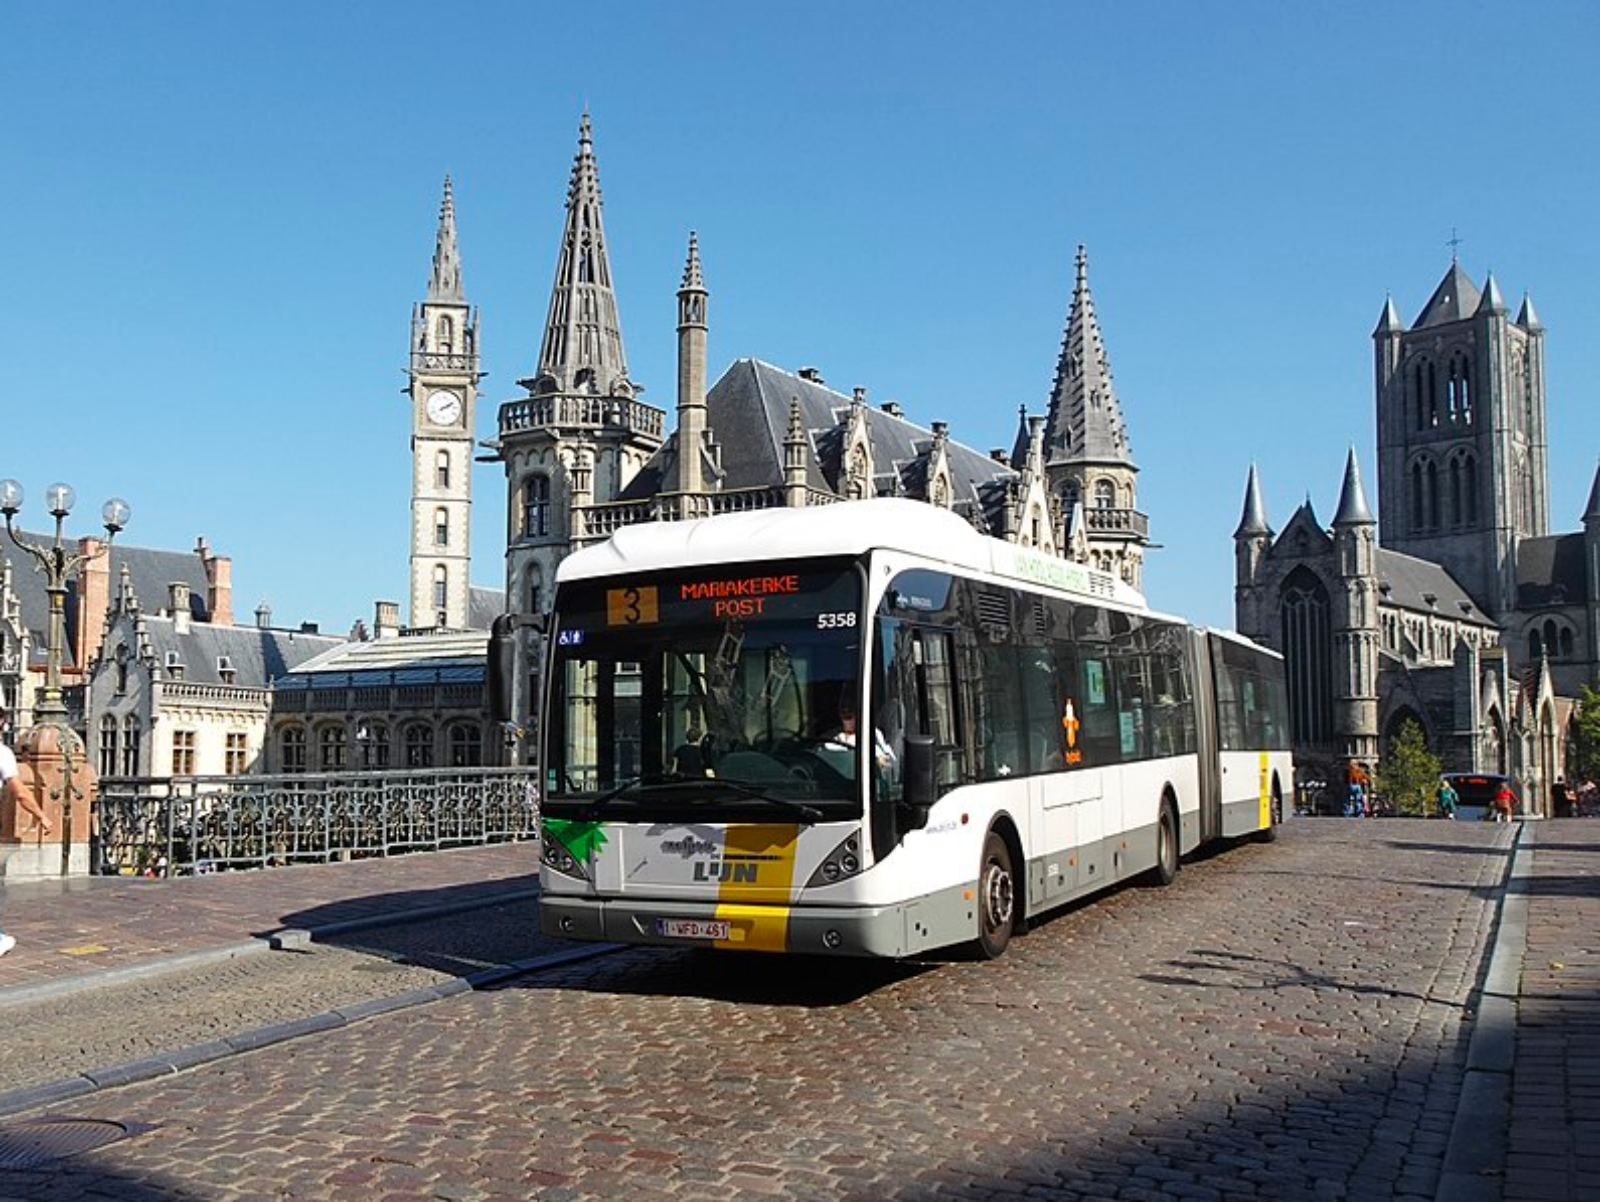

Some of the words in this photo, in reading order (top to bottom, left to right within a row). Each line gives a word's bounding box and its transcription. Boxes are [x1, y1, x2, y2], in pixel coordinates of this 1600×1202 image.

[682, 575, 799, 599] MARIAKERKE
[622, 588, 642, 623] 3
[716, 599, 764, 617] POST
[817, 613, 857, 629] 5358
